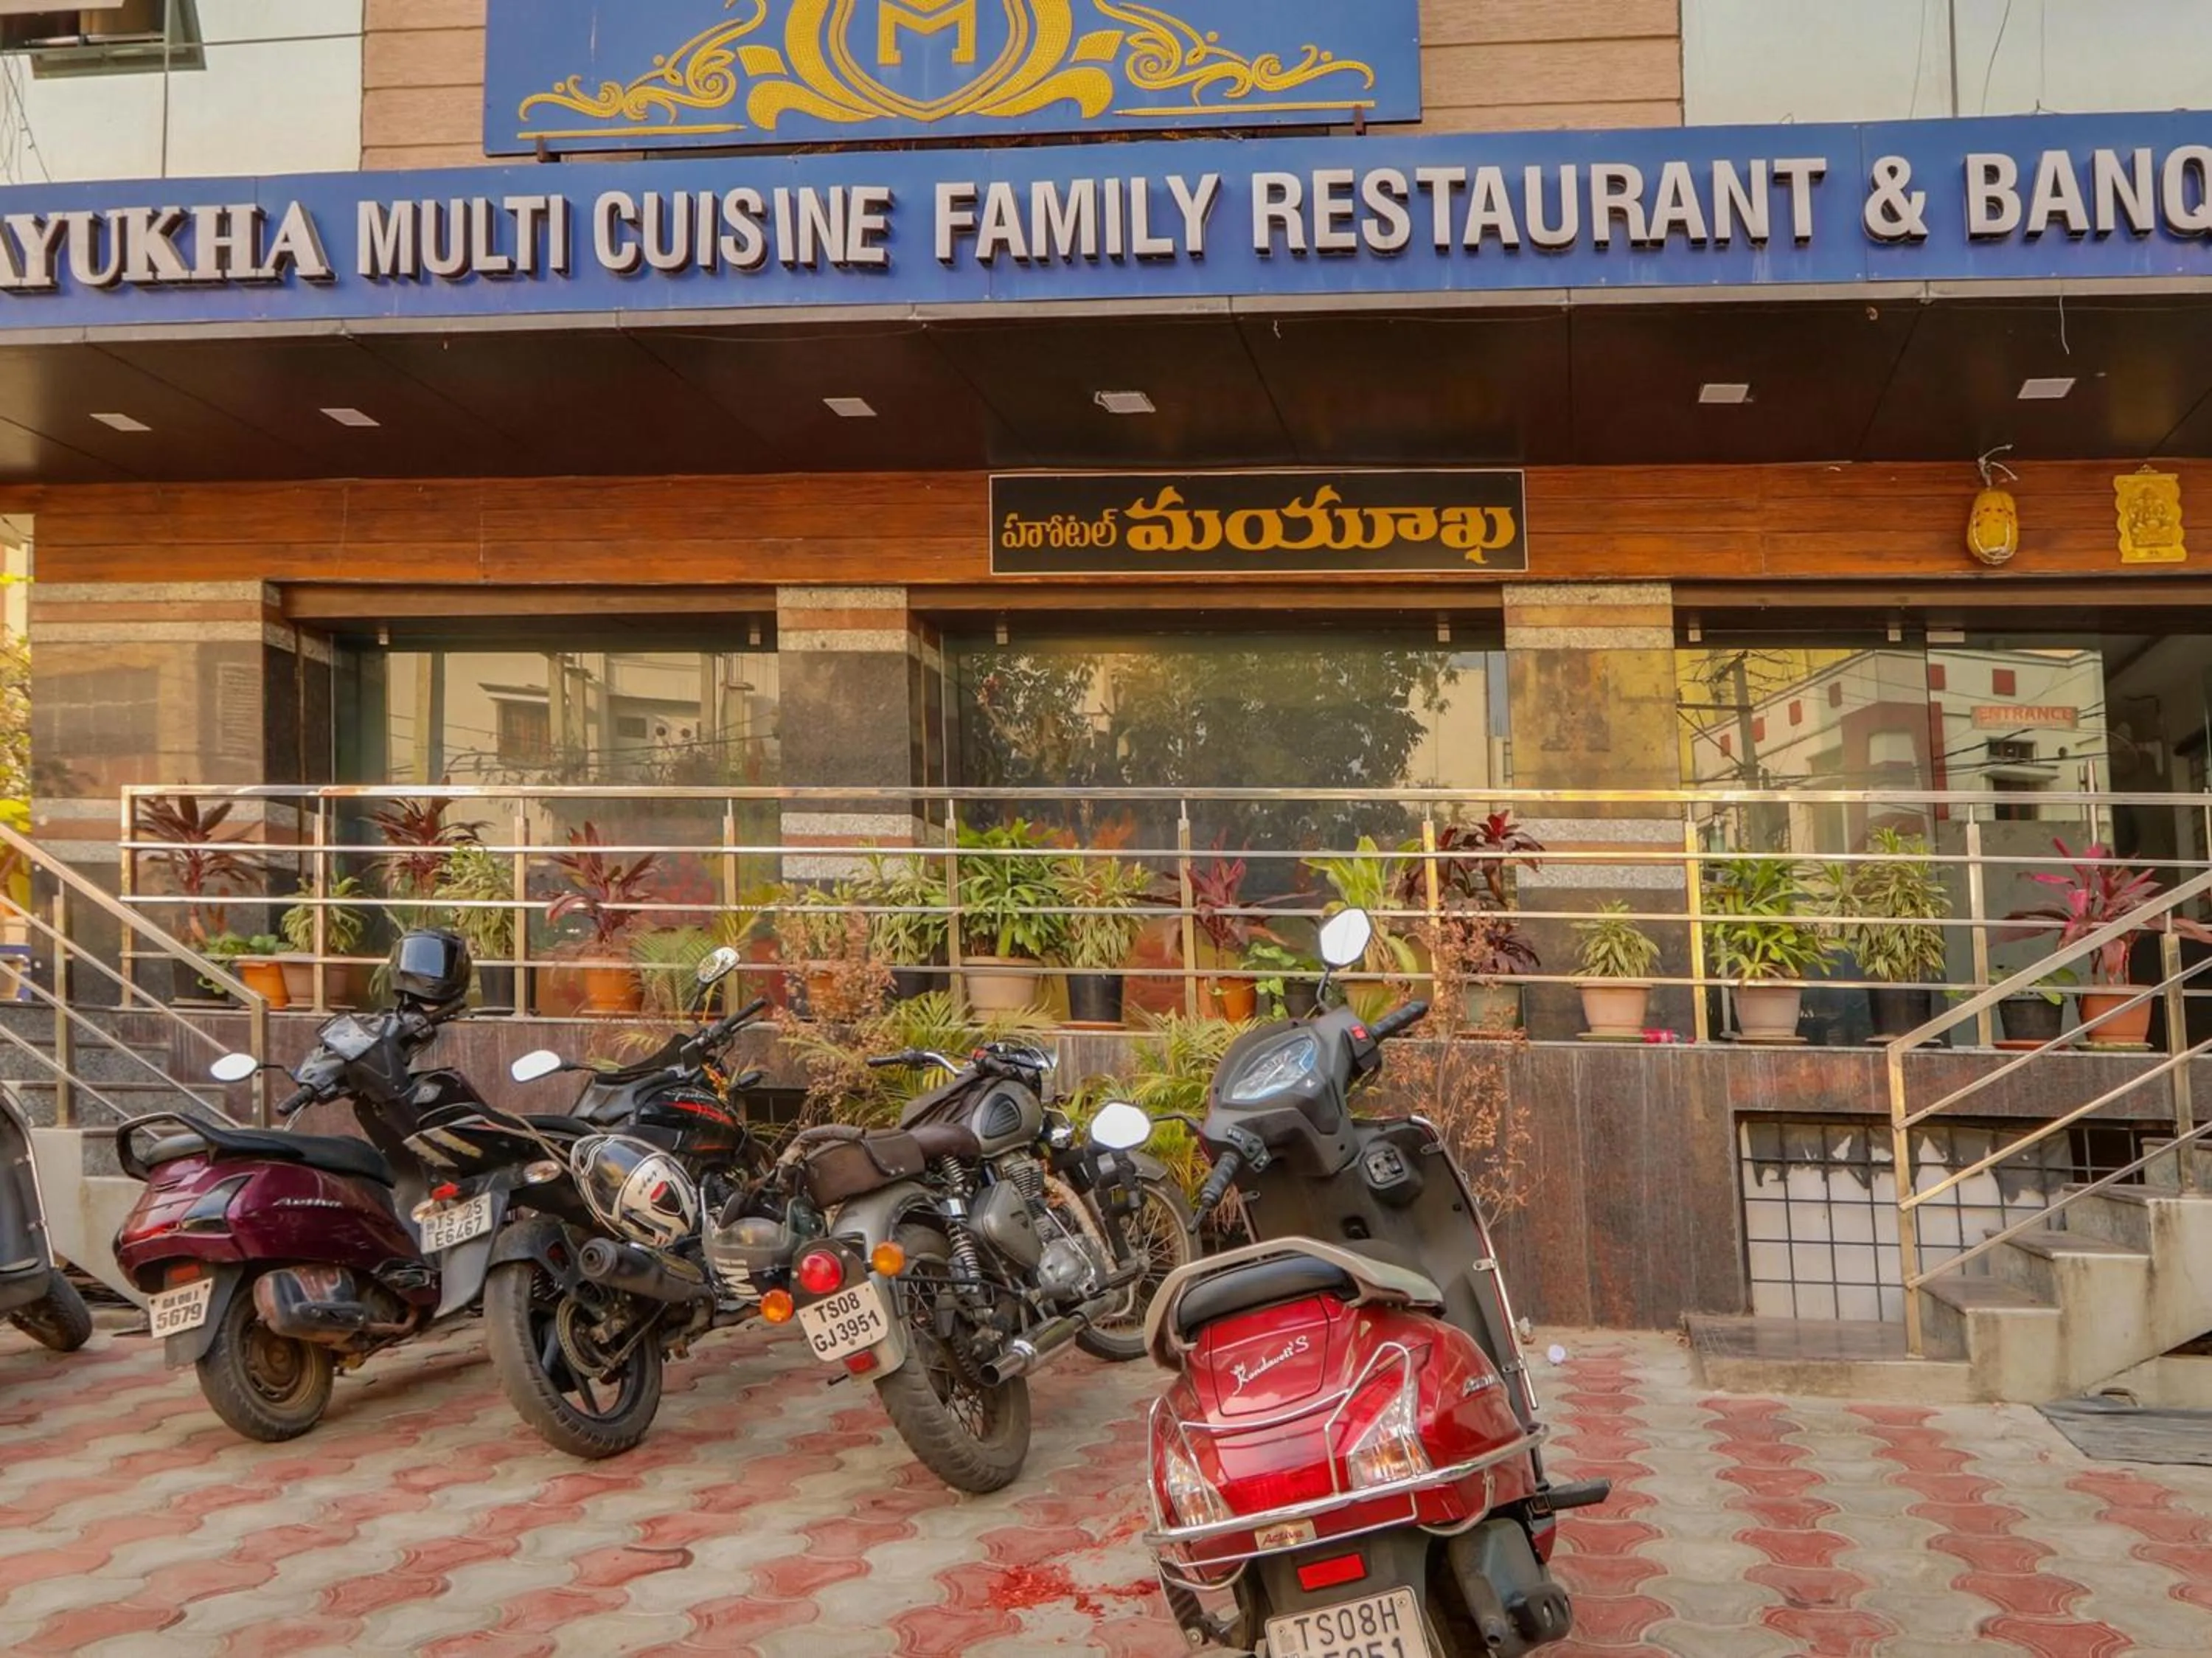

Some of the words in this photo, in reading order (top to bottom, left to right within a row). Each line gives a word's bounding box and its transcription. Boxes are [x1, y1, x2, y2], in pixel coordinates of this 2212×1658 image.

[358, 194, 571, 282] MULTI
[594, 185, 894, 274] CUISINE
[934, 173, 1220, 265] FAMILY
[1251, 157, 1827, 257] RESTAURANT
[1863, 155, 1929, 244] &
[1964, 145, 2212, 241] BANQ
[1980, 707, 2071, 721] ENTRANCE
[156, 1302, 202, 1330] 5679
[813, 1291, 861, 1323] TS08
[813, 1309, 881, 1352] GJ3951
[1293, 1597, 1399, 1651] TS08H
